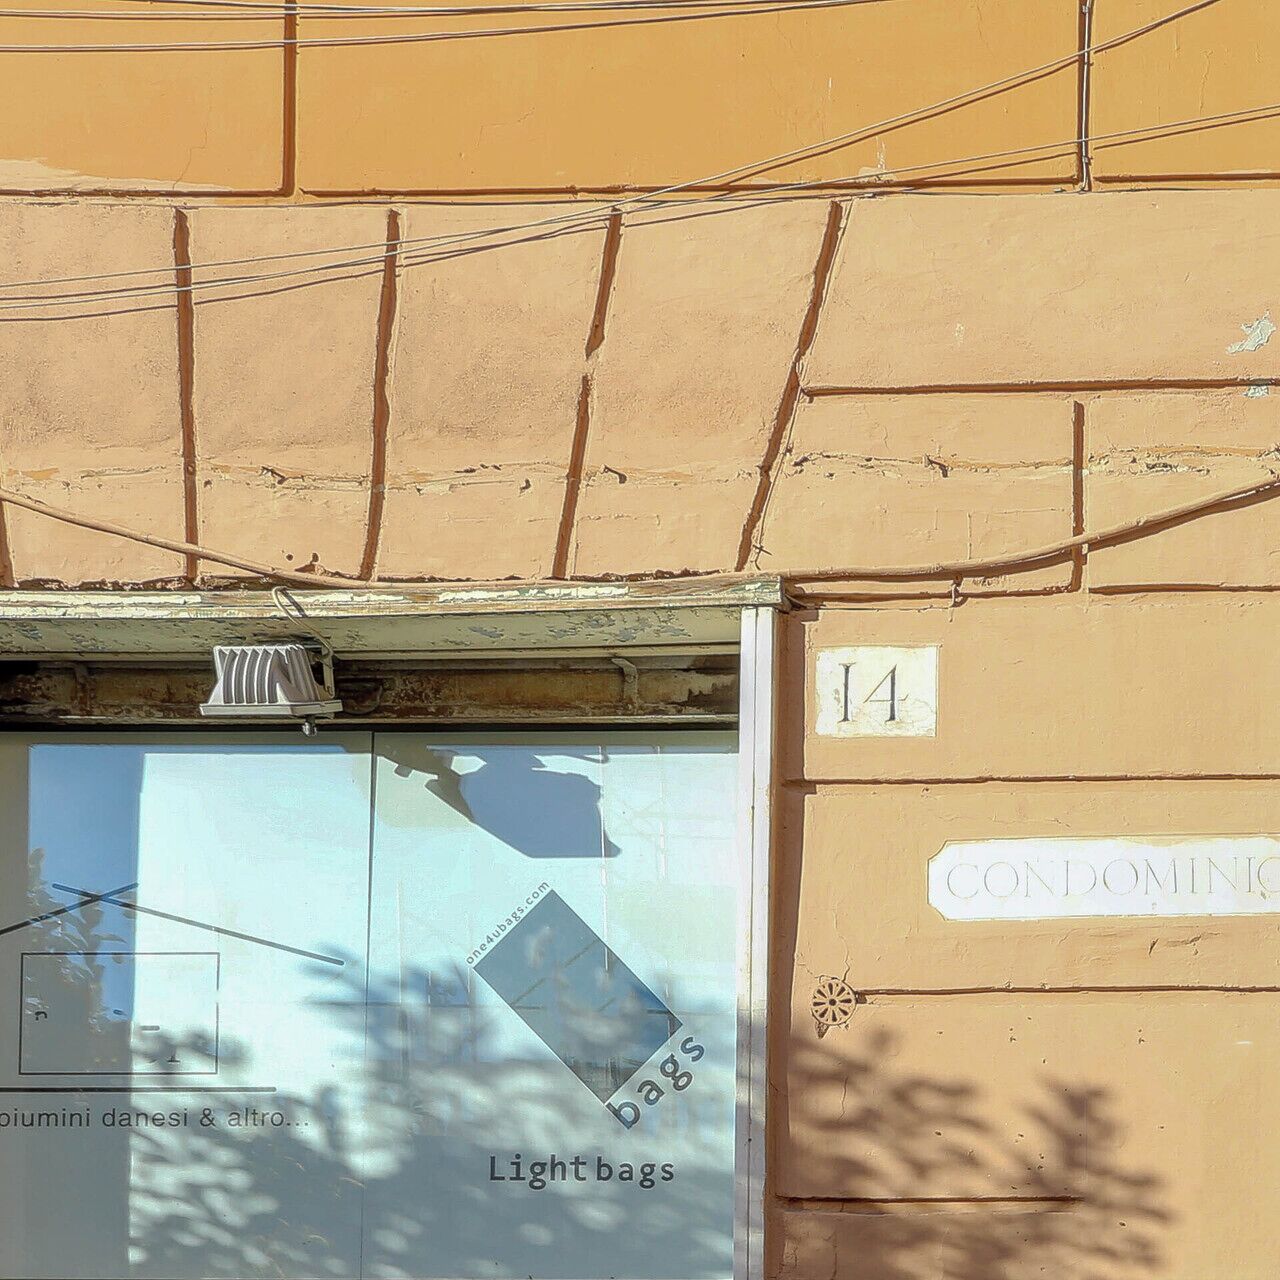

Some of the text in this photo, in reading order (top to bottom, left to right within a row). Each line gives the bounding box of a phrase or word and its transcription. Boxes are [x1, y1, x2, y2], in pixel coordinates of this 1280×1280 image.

[838, 662, 909, 723] 14
[466, 881, 550, 965] one4ubags.com
[102, 1108, 188, 1128] danesi
[199, 1108, 217, 1128] &
[228, 1108, 310, 1128] altro...
[605, 1036, 705, 1130] bags
